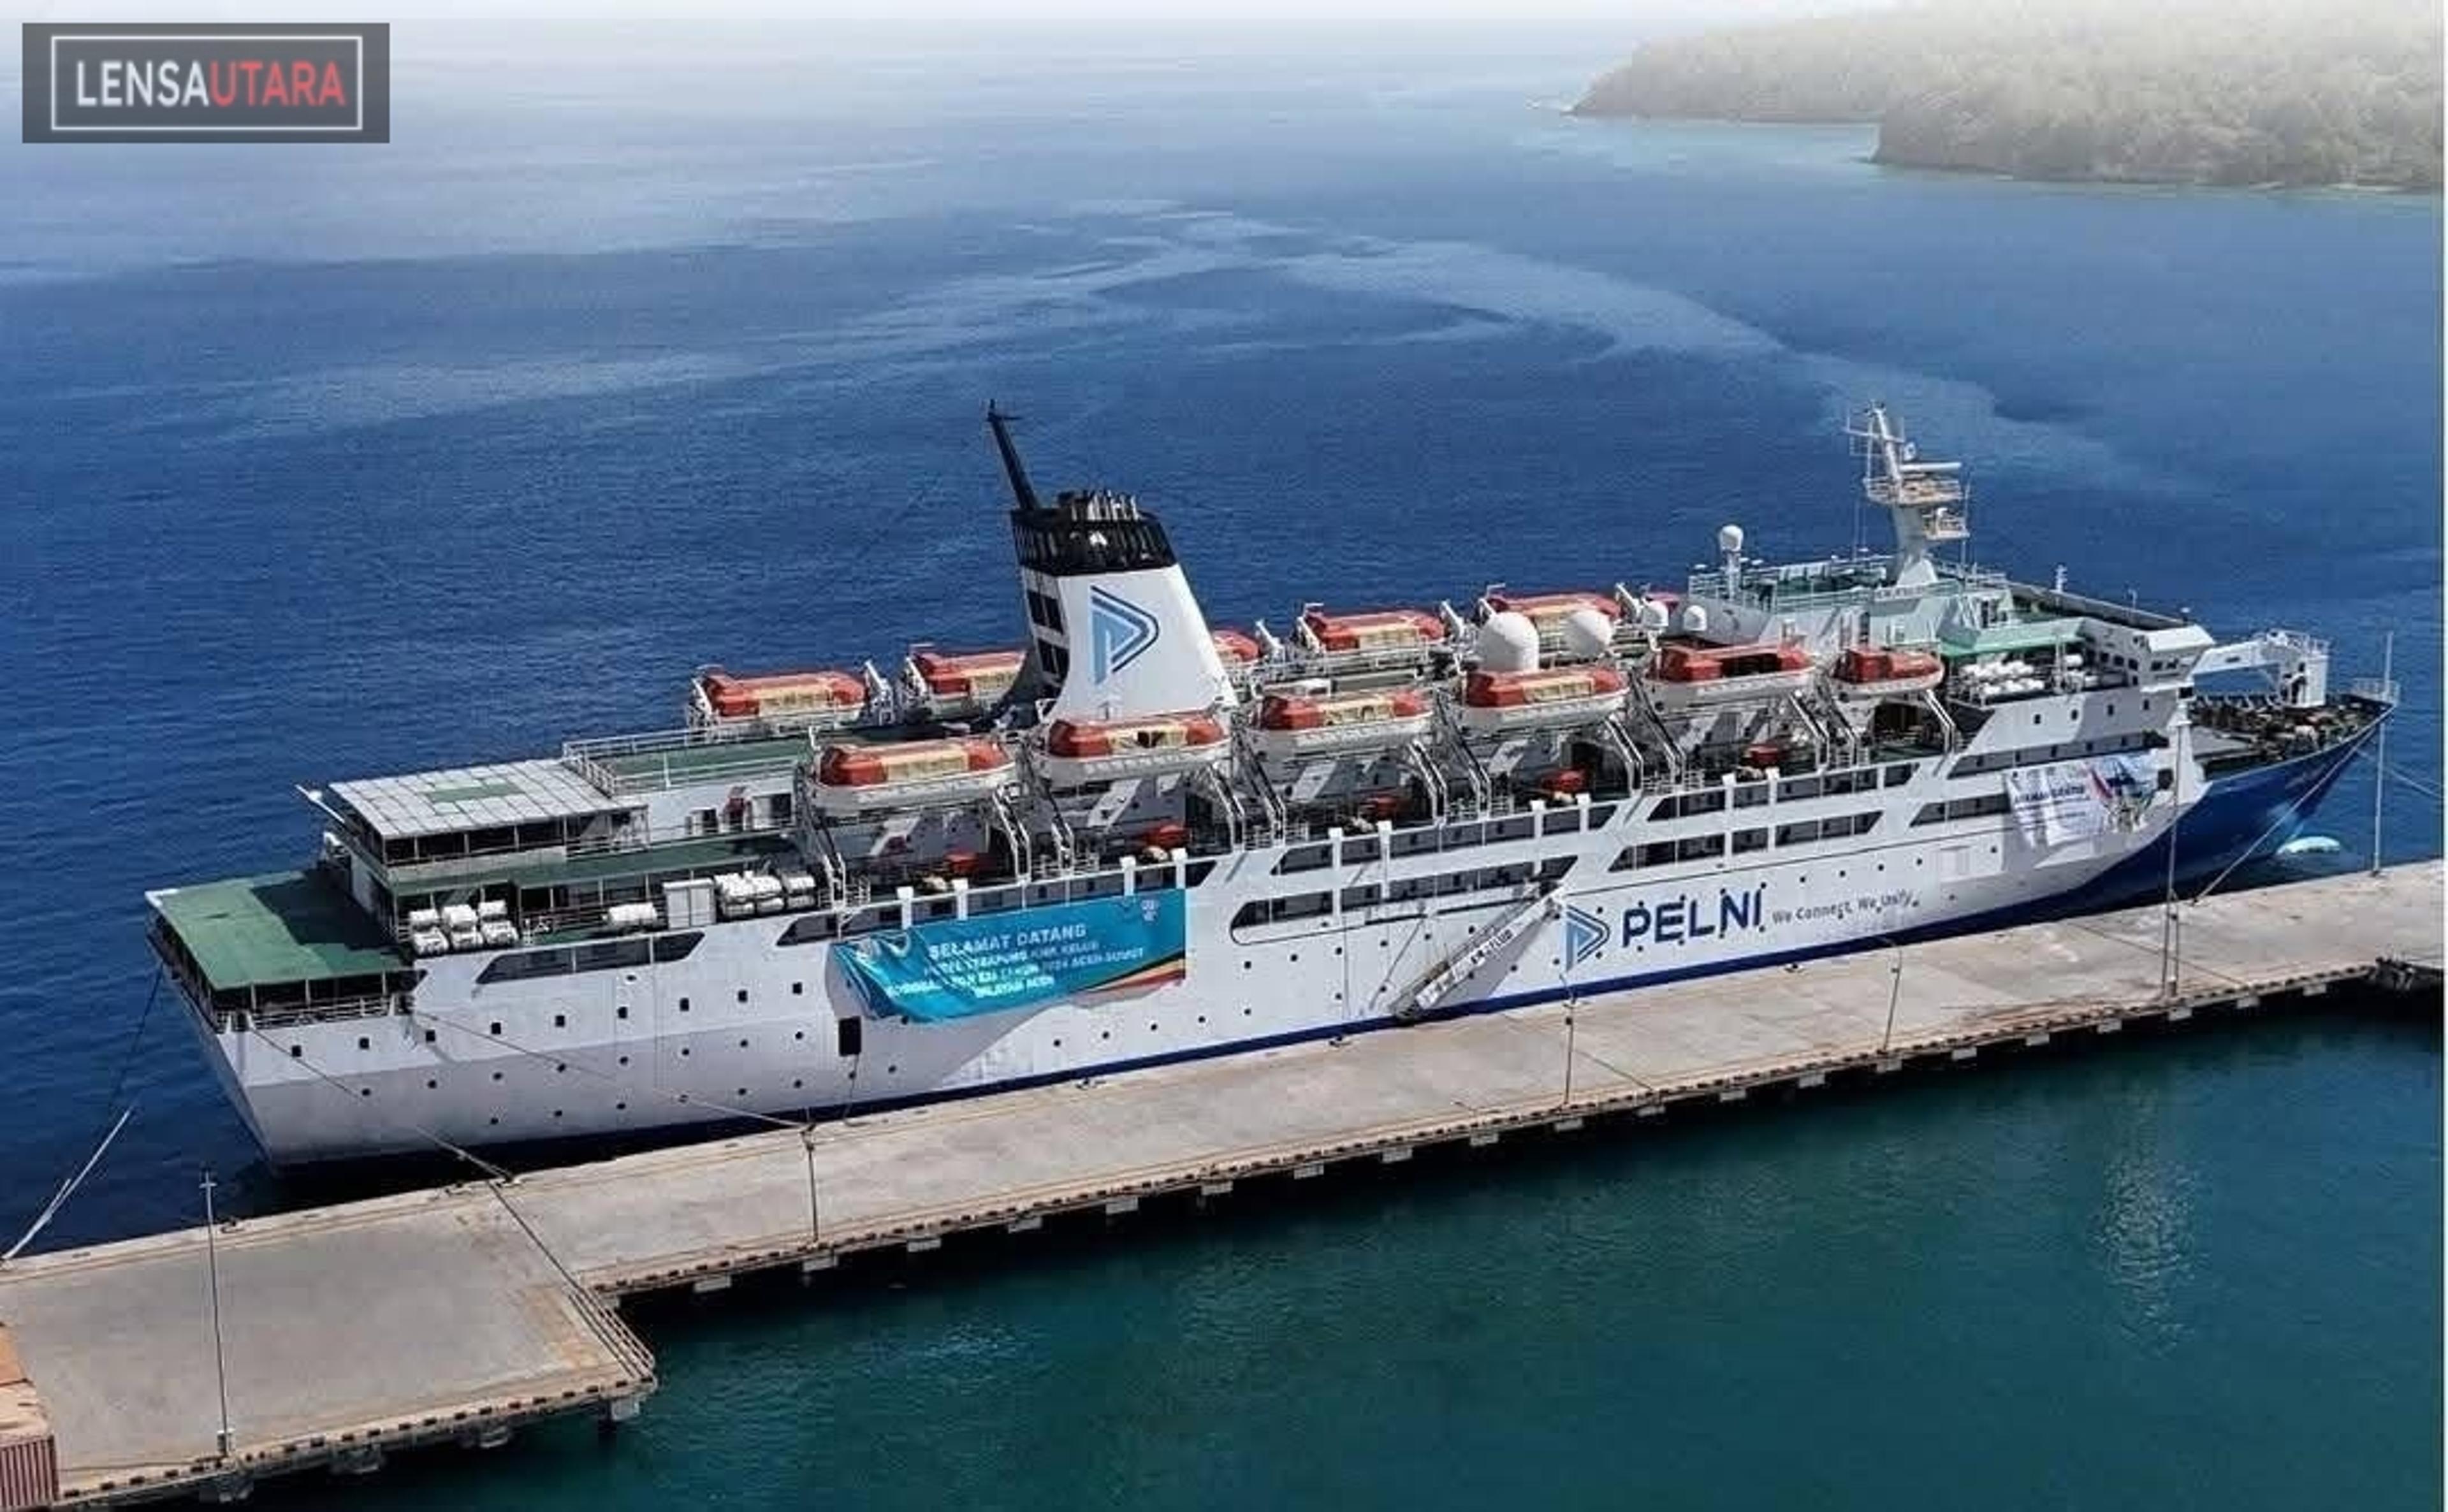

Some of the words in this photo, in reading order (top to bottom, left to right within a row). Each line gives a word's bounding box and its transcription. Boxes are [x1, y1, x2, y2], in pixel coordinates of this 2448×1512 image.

[1622, 889, 1761, 948] PELNI
[1772, 910, 1792, 924] We
[928, 934, 1010, 961] SELAMAT
[1017, 924, 1086, 947] DATANG
